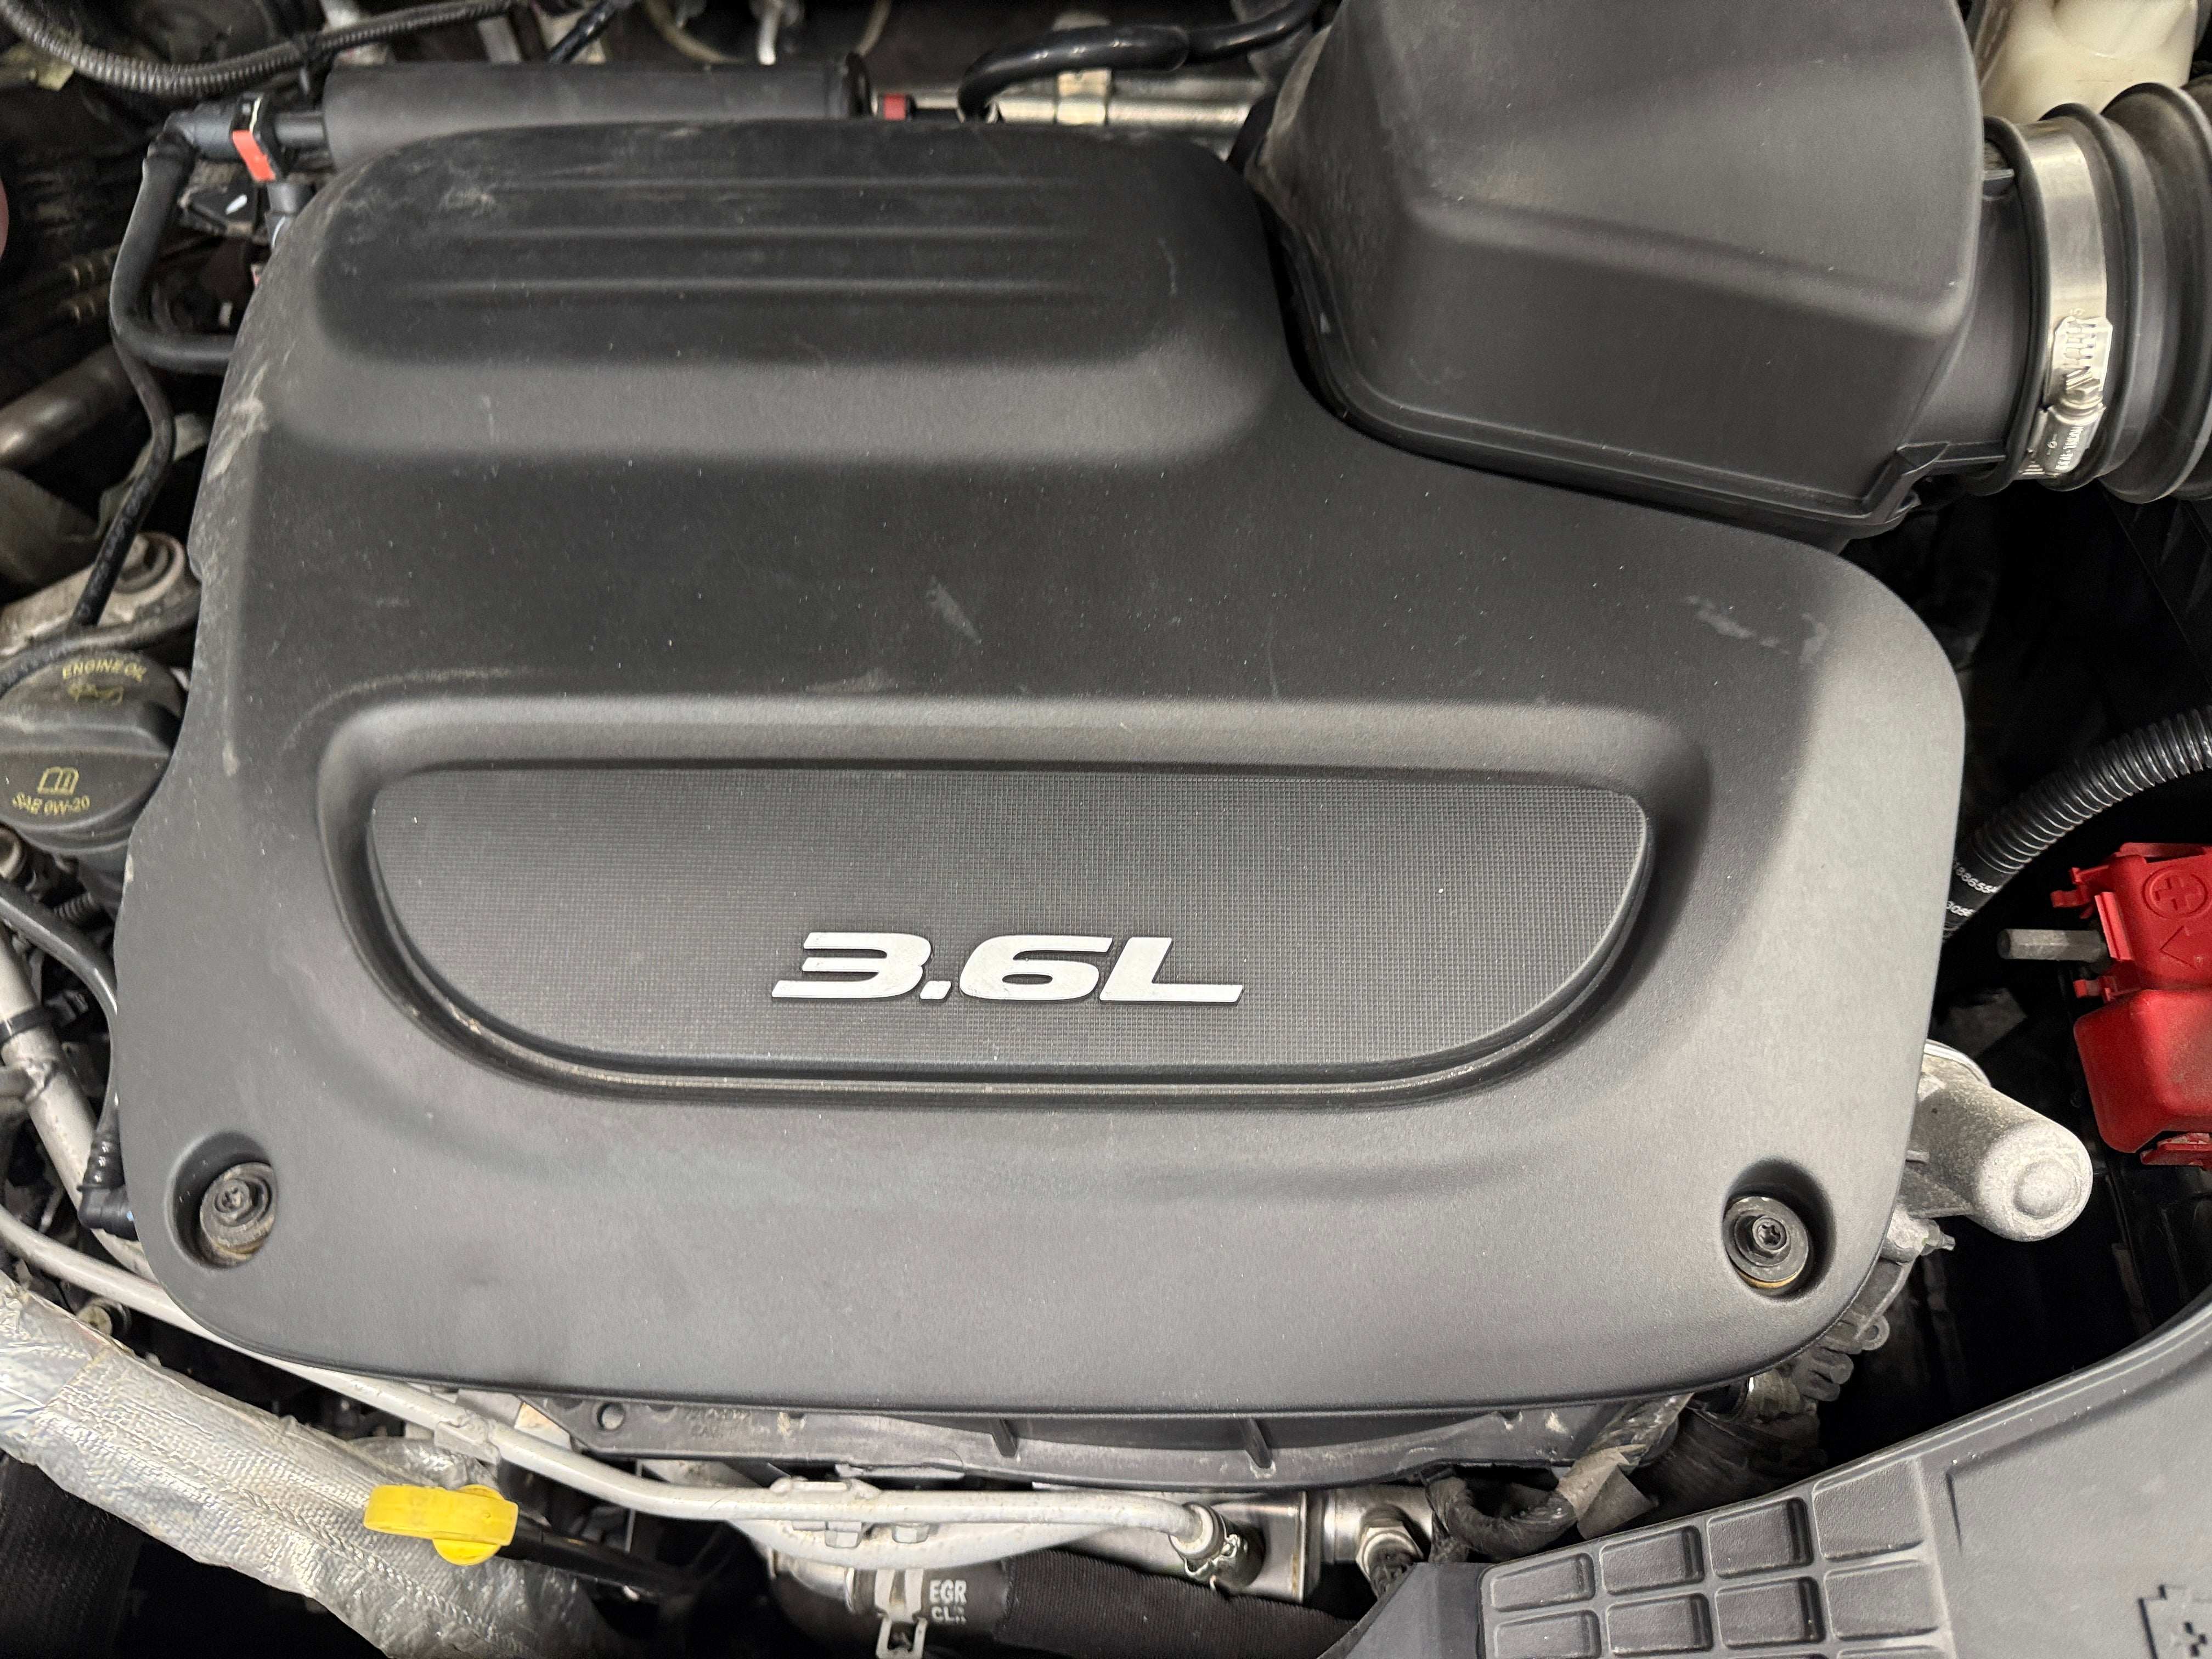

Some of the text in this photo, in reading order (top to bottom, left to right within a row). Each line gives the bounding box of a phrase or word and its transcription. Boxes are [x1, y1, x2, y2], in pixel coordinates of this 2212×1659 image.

[62, 658, 124, 680] ENGINE
[771, 932, 1244, 1002] 3.6L
[929, 1579, 967, 1604] EGR
